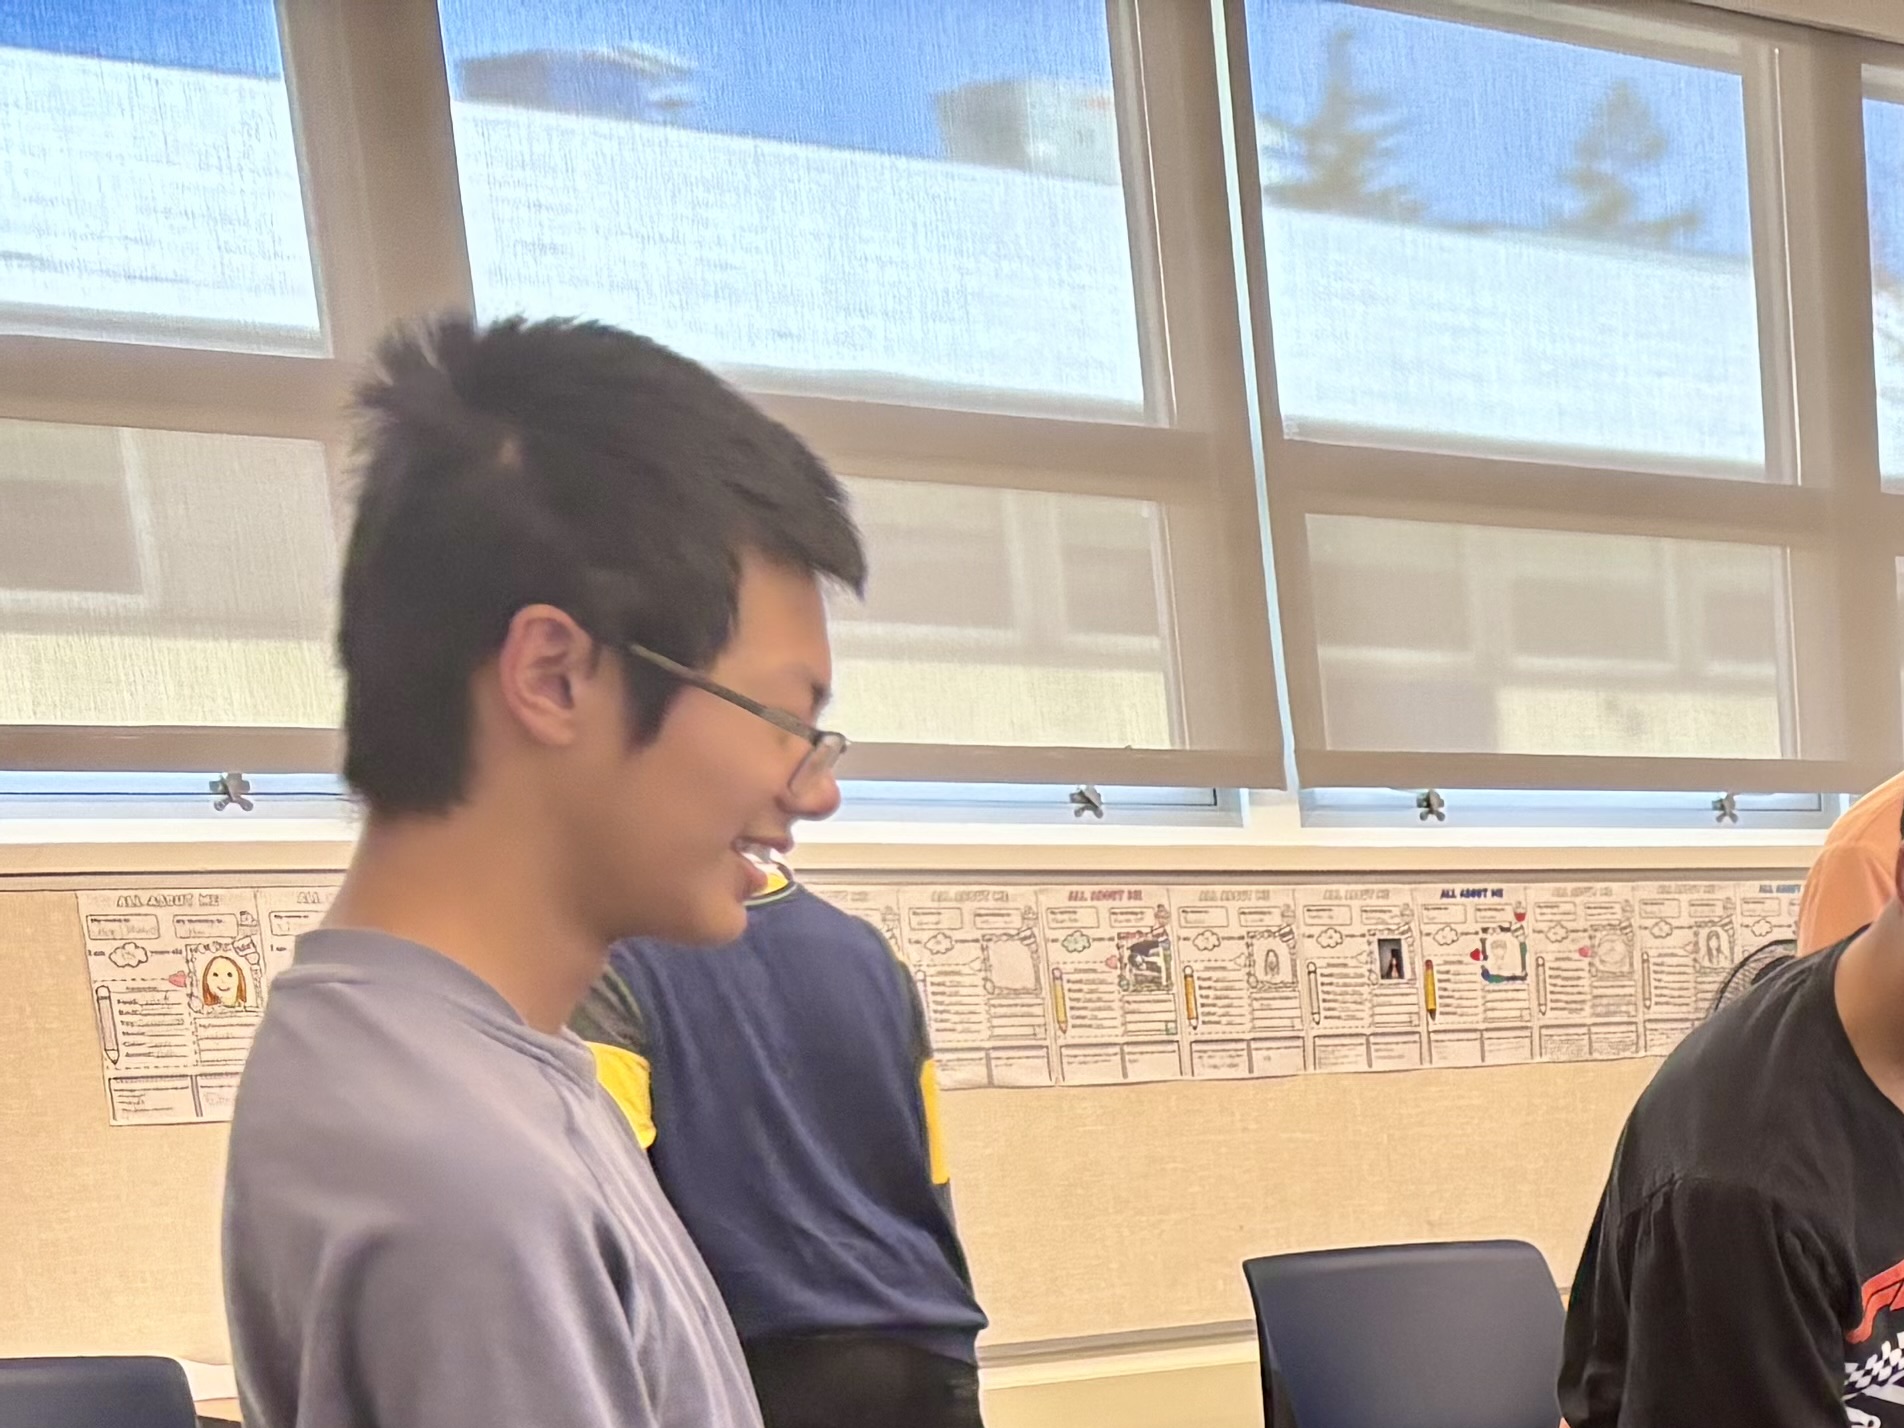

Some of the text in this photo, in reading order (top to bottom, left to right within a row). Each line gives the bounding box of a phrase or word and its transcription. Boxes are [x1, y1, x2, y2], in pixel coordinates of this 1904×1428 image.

[1440, 888, 1504, 899] ALL ABOUT ME
[117, 893, 220, 907] ALL ABOUT ME
